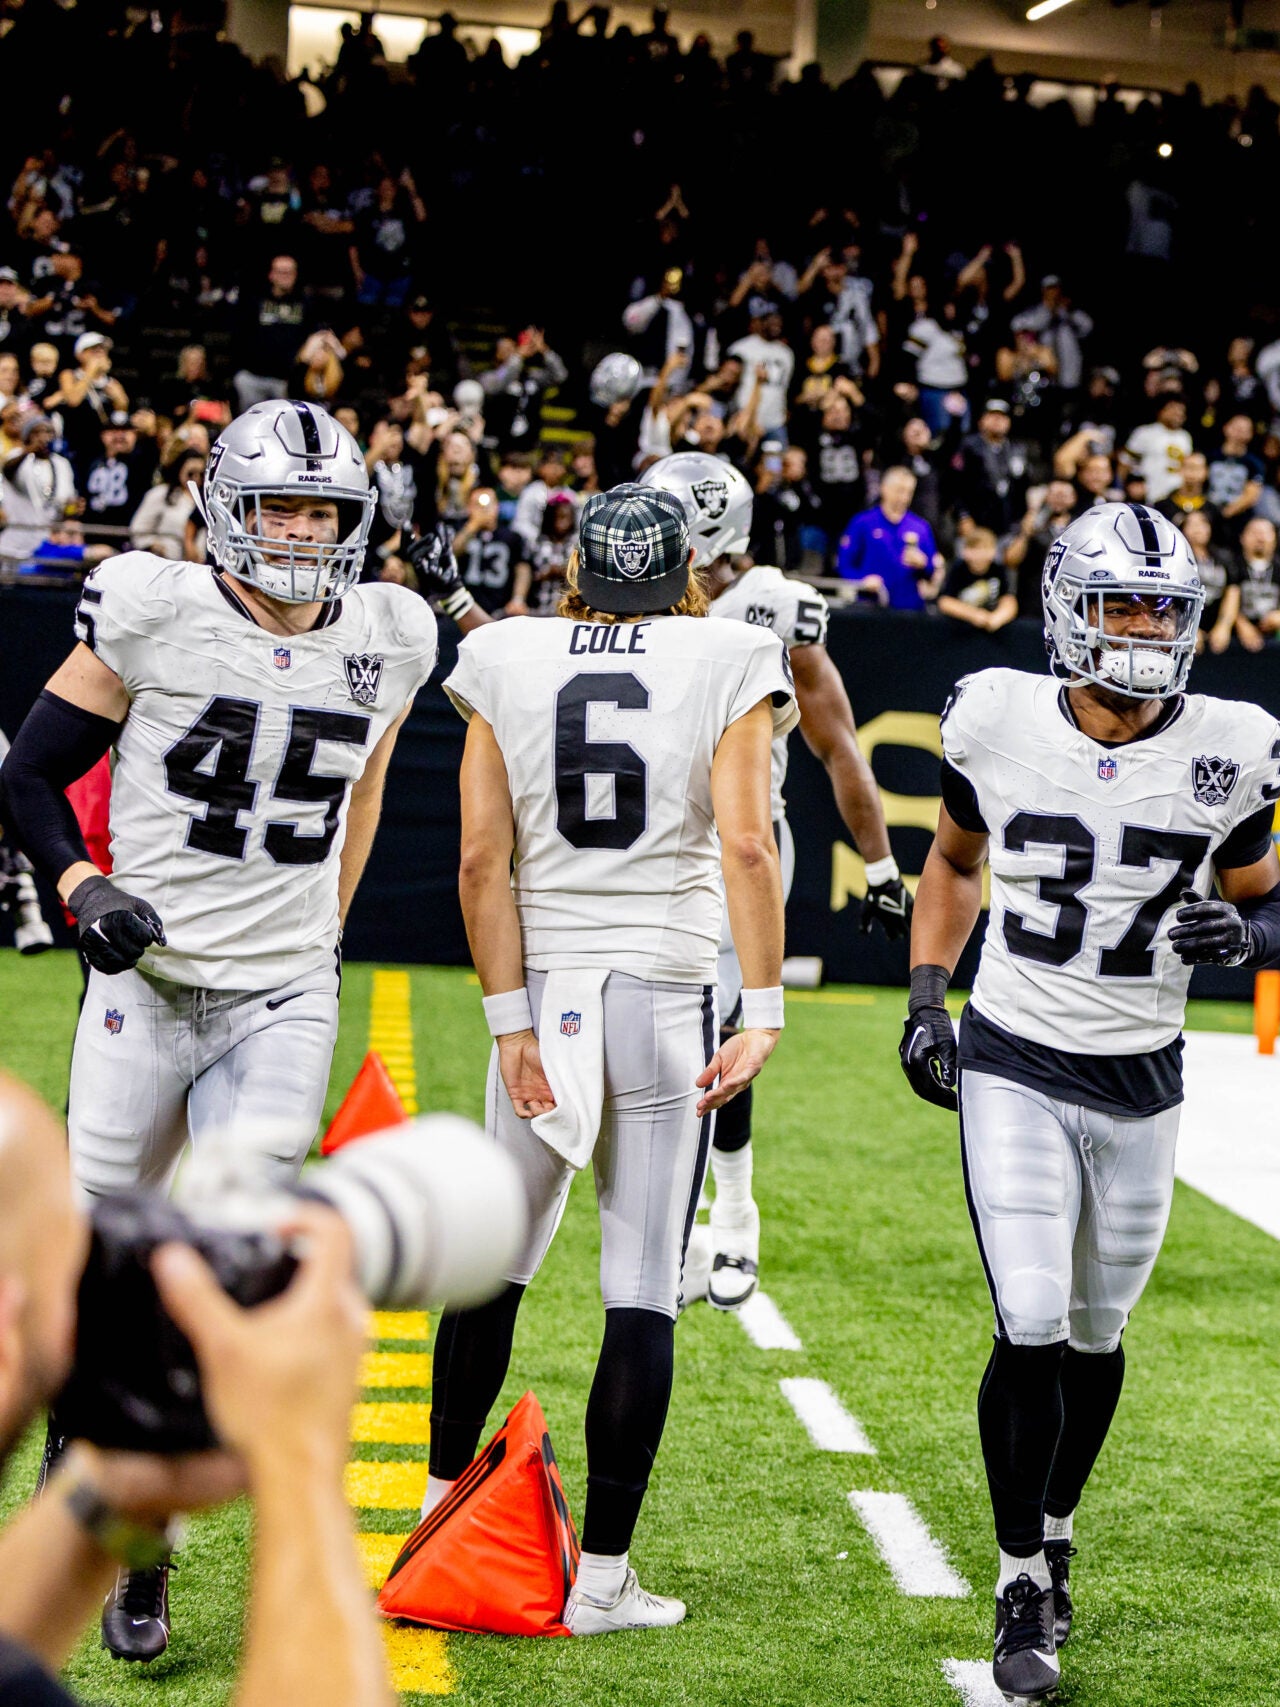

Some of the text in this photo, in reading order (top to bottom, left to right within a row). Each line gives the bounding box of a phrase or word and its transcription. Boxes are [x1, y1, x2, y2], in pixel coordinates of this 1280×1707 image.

[297, 475, 332, 483] RAIDERS
[464, 540, 511, 587] 13
[1138, 570, 1171, 580] RAIDERS
[569, 623, 652, 655] COLE
[275, 656, 290, 667] NFL
[351, 667, 379, 685] LXV
[553, 671, 652, 852] 6
[162, 694, 373, 867] 45
[1100, 767, 1115, 779] NFL
[1197, 770, 1234, 788] LXV
[1001, 809, 1213, 980] 37
[562, 1021, 579, 1034] NFL
